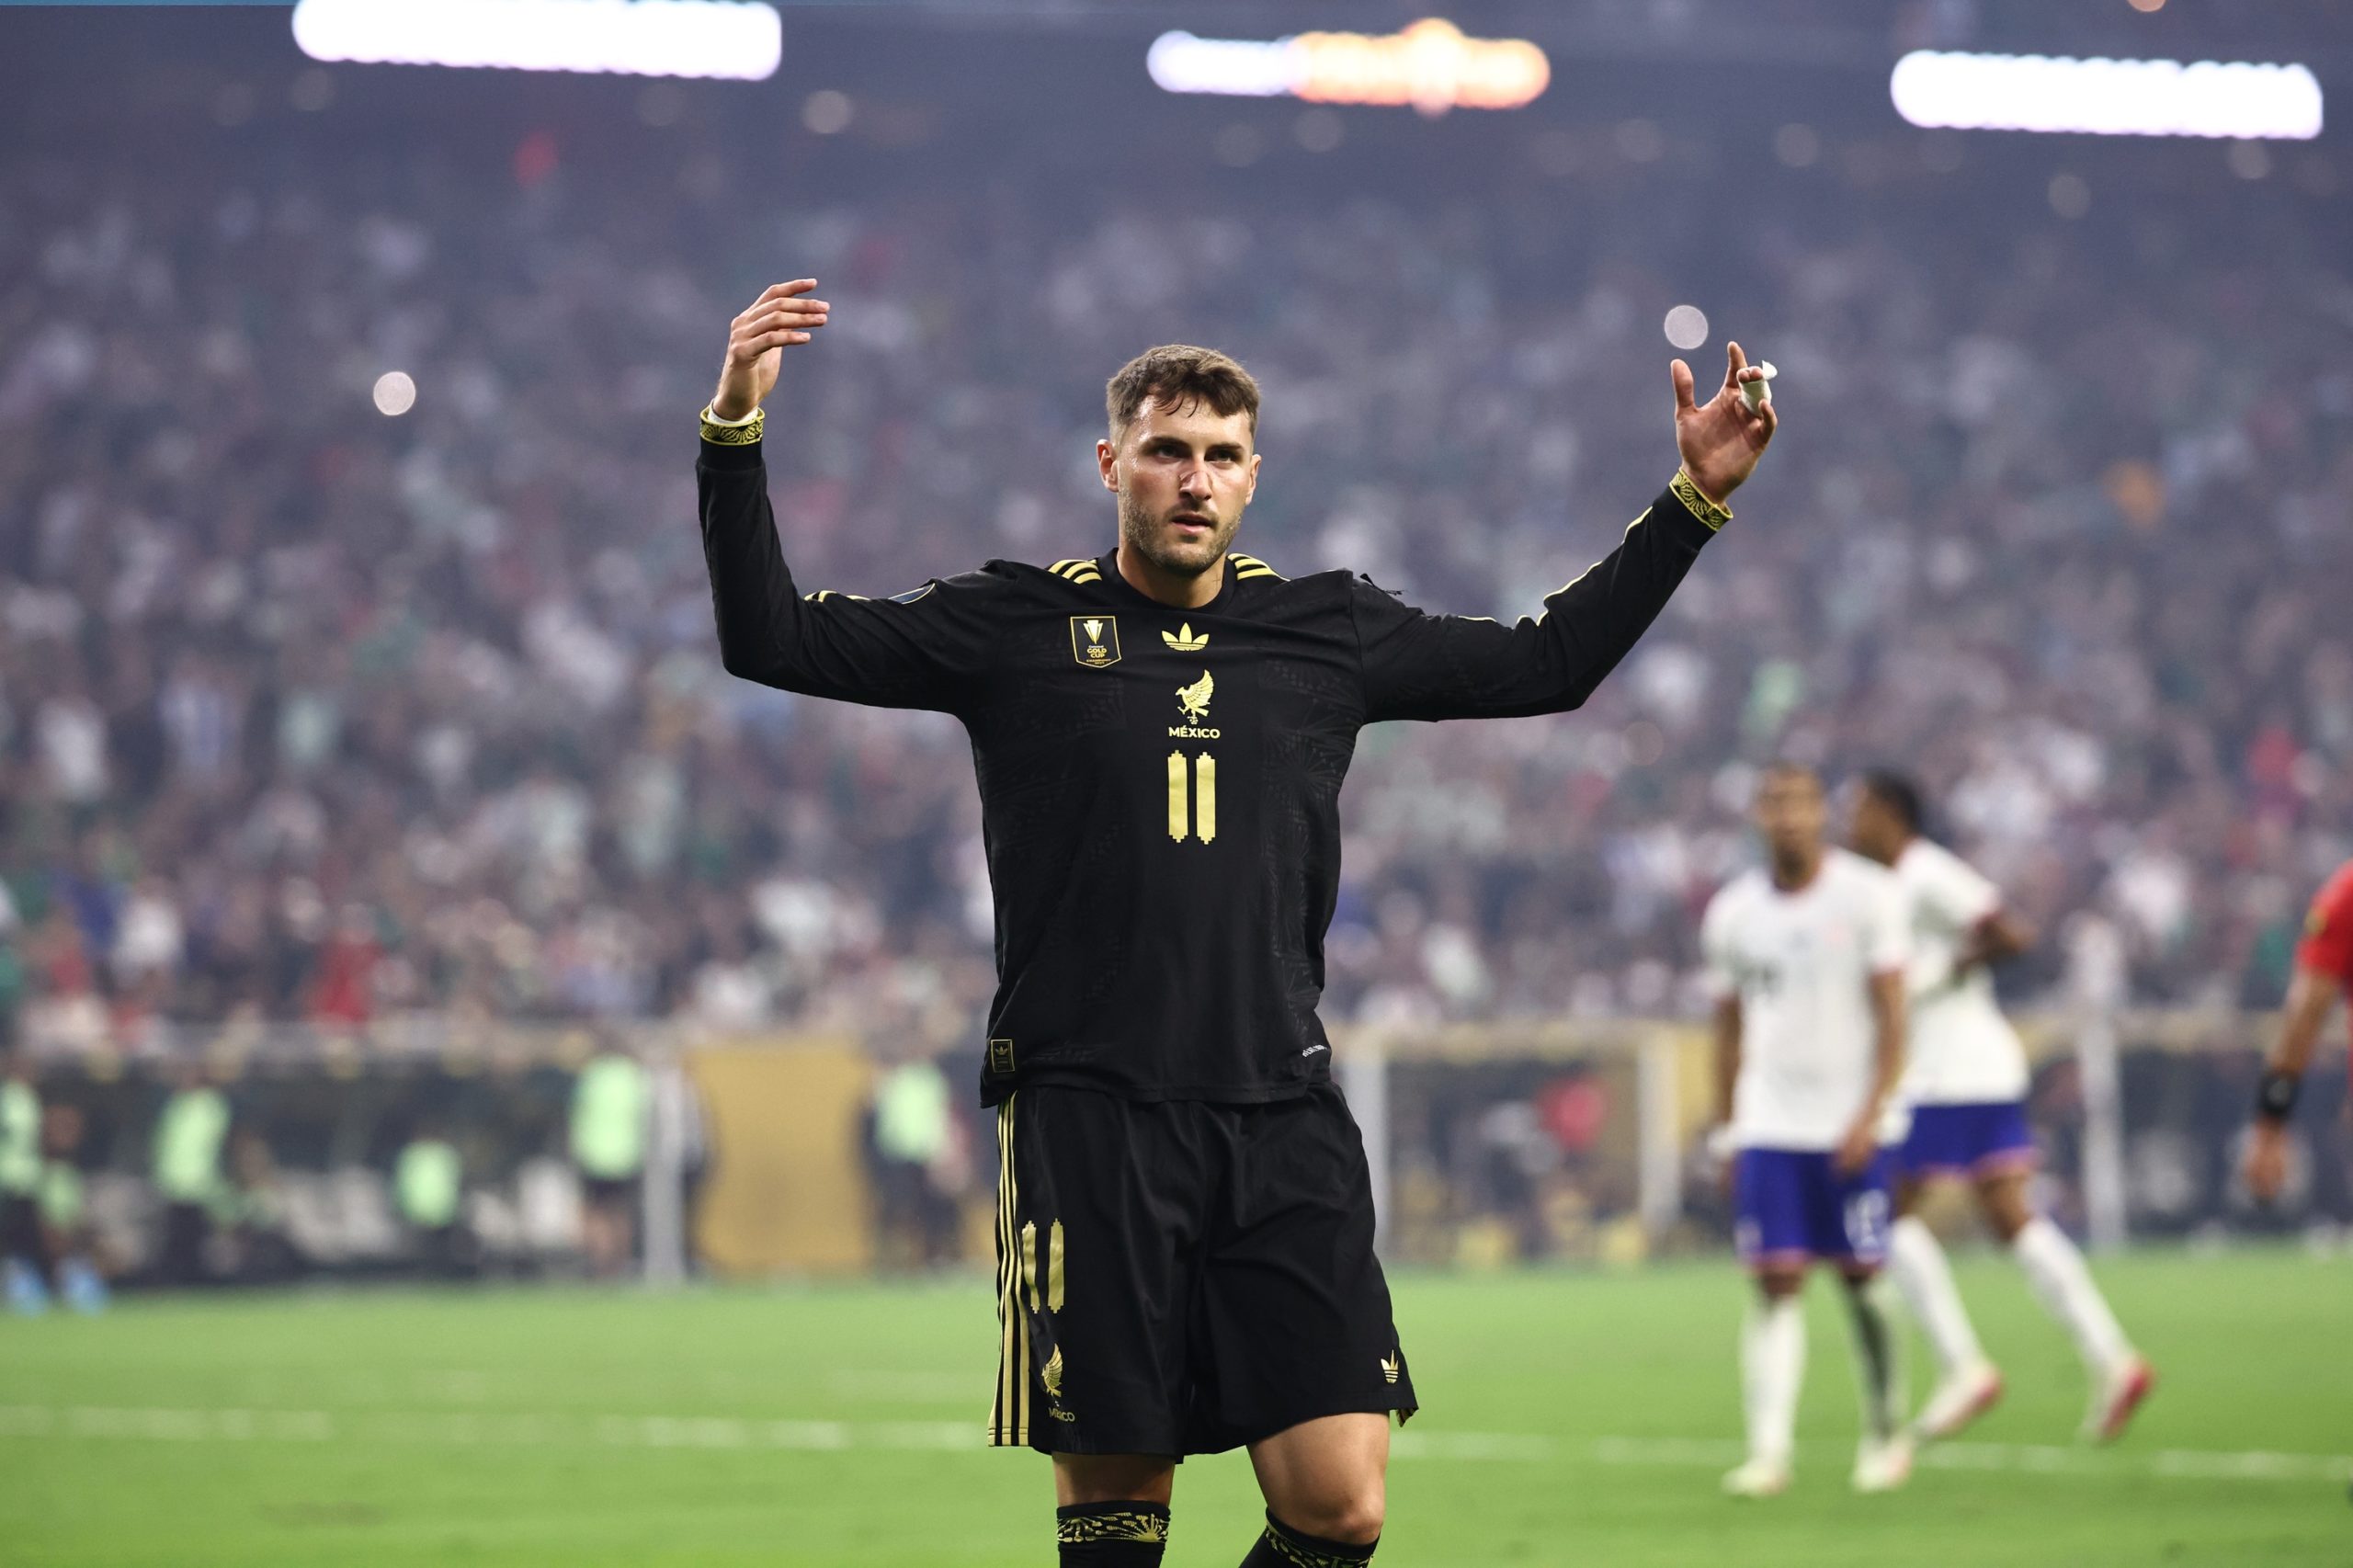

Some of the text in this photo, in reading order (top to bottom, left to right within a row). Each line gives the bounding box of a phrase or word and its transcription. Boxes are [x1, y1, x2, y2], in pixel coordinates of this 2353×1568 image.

[1168, 725, 1221, 739] MÉXICO
[1167, 749, 1216, 845] 11
[1021, 1218, 1064, 1314] 11
